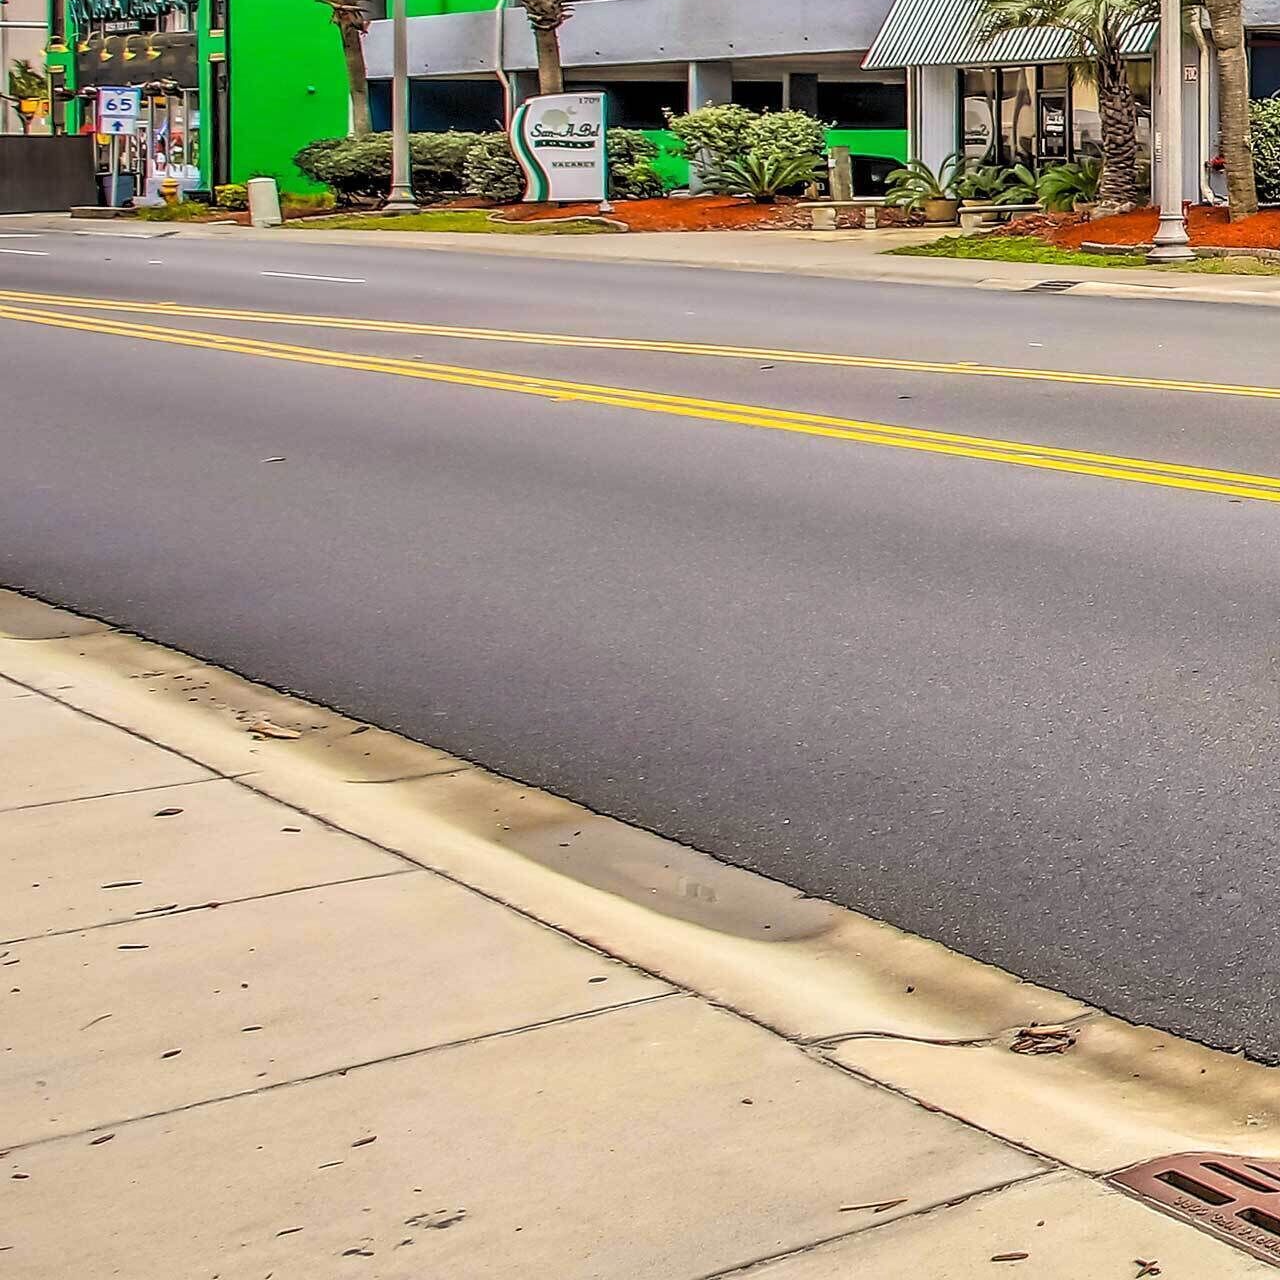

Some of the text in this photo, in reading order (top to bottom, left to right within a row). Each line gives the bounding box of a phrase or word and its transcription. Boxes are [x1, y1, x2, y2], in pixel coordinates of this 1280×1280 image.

[106, 98, 132, 111] 65
[579, 96, 600, 104] 1709
[530, 122, 600, 138] San-A-Bel
[552, 161, 596, 169] VACANCY
